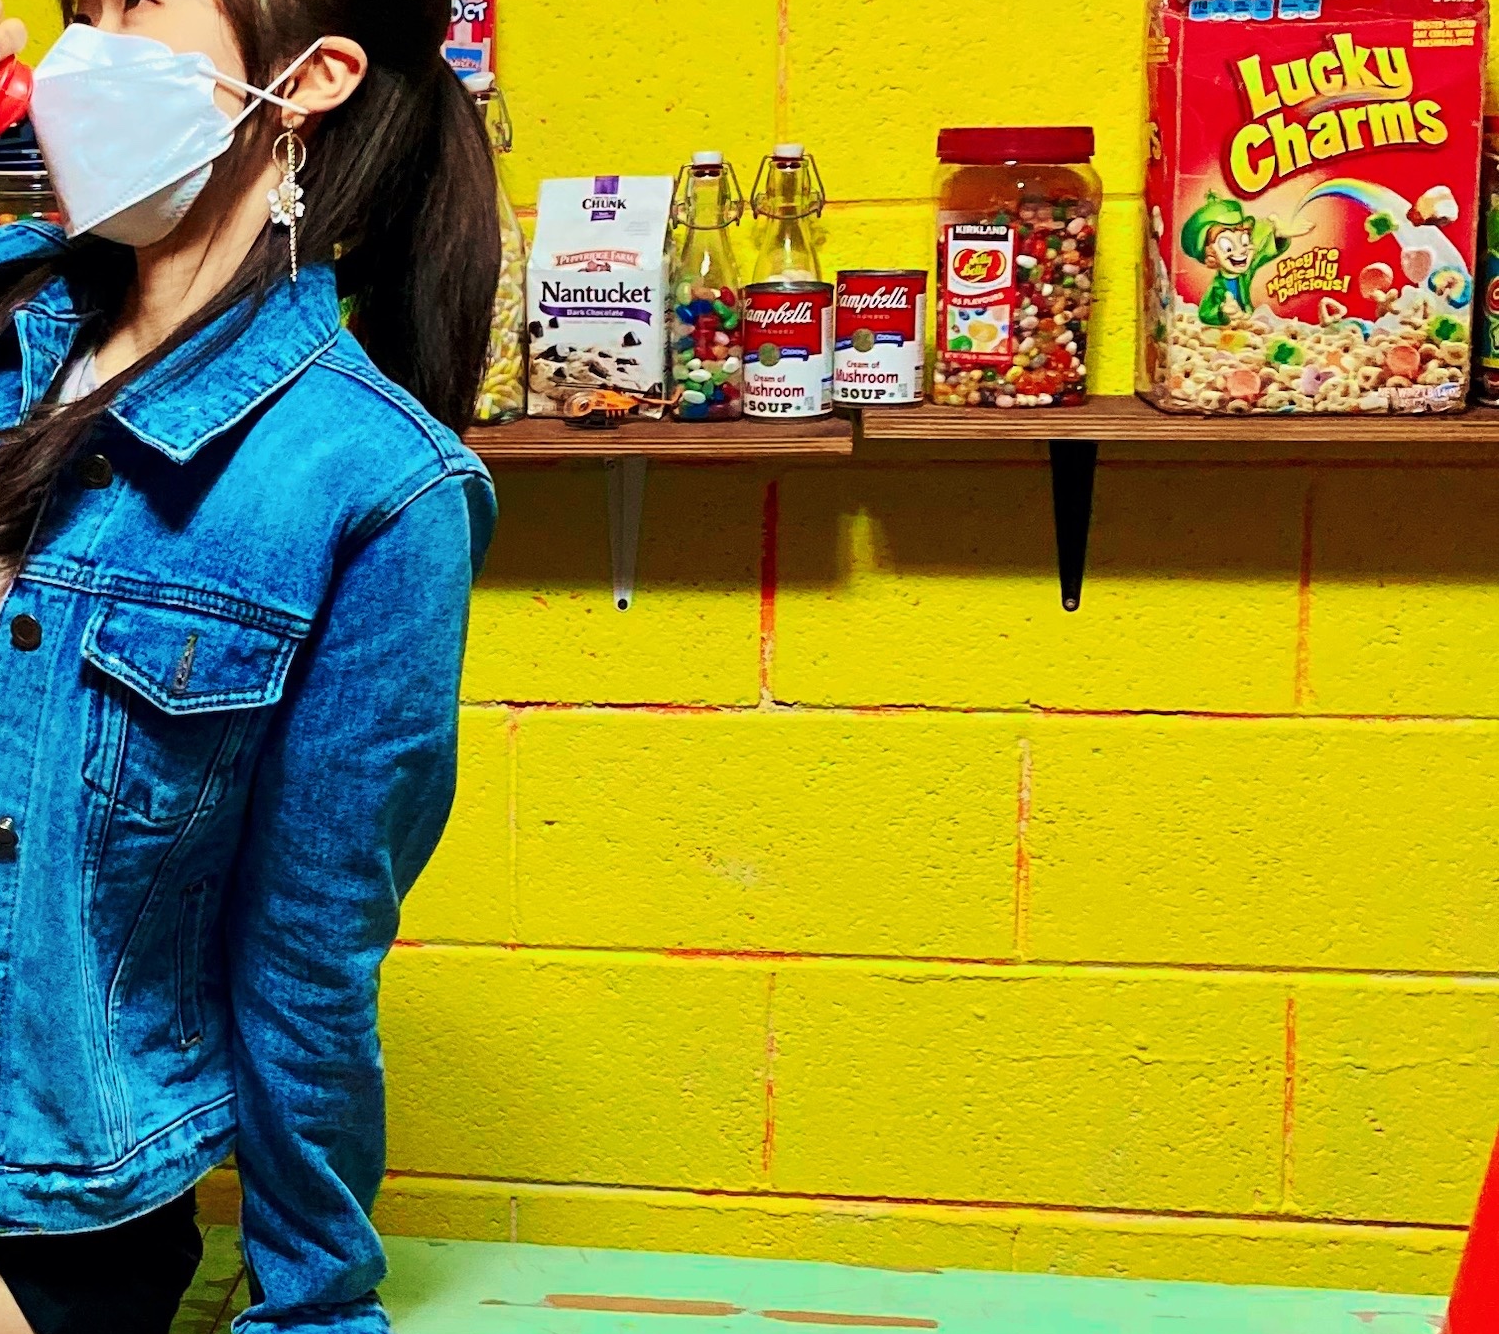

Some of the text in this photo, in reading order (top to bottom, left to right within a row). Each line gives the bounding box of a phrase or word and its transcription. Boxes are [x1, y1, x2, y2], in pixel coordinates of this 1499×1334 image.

[1237, 33, 1413, 120] Lucky
[1230, 100, 1449, 193] Charms
[582, 197, 627, 210] CHUNK
[955, 225, 1007, 236] KIRKLAND
[541, 281, 652, 304] Nantucket
[1277, 275, 1352, 303] Delicious!
[841, 387, 886, 400] SOUP
[748, 400, 793, 413] SOUP
